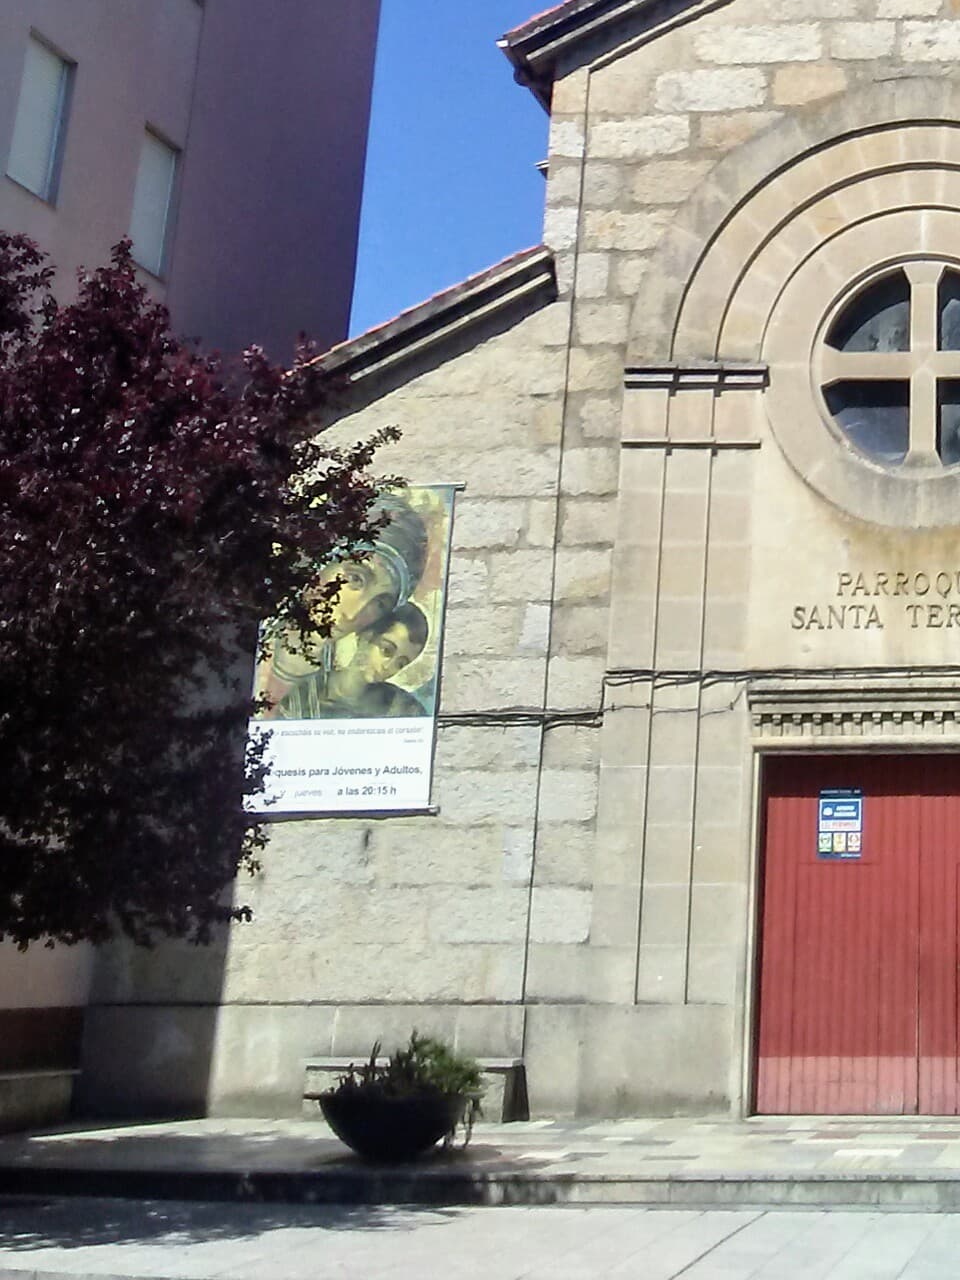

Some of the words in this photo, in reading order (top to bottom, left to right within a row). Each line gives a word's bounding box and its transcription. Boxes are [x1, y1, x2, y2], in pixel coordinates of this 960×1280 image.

[791, 604, 884, 630] SANTA
[275, 768, 306, 778] quesis
[309, 768, 329, 778] para
[332, 766, 372, 775] Jóvenes
[375, 767, 381, 776] y
[383, 765, 423, 774] Adultos,
[337, 788, 343, 796] a
[346, 786, 359, 795] las
[362, 786, 388, 795] 20:15
[390, 786, 397, 795] h
